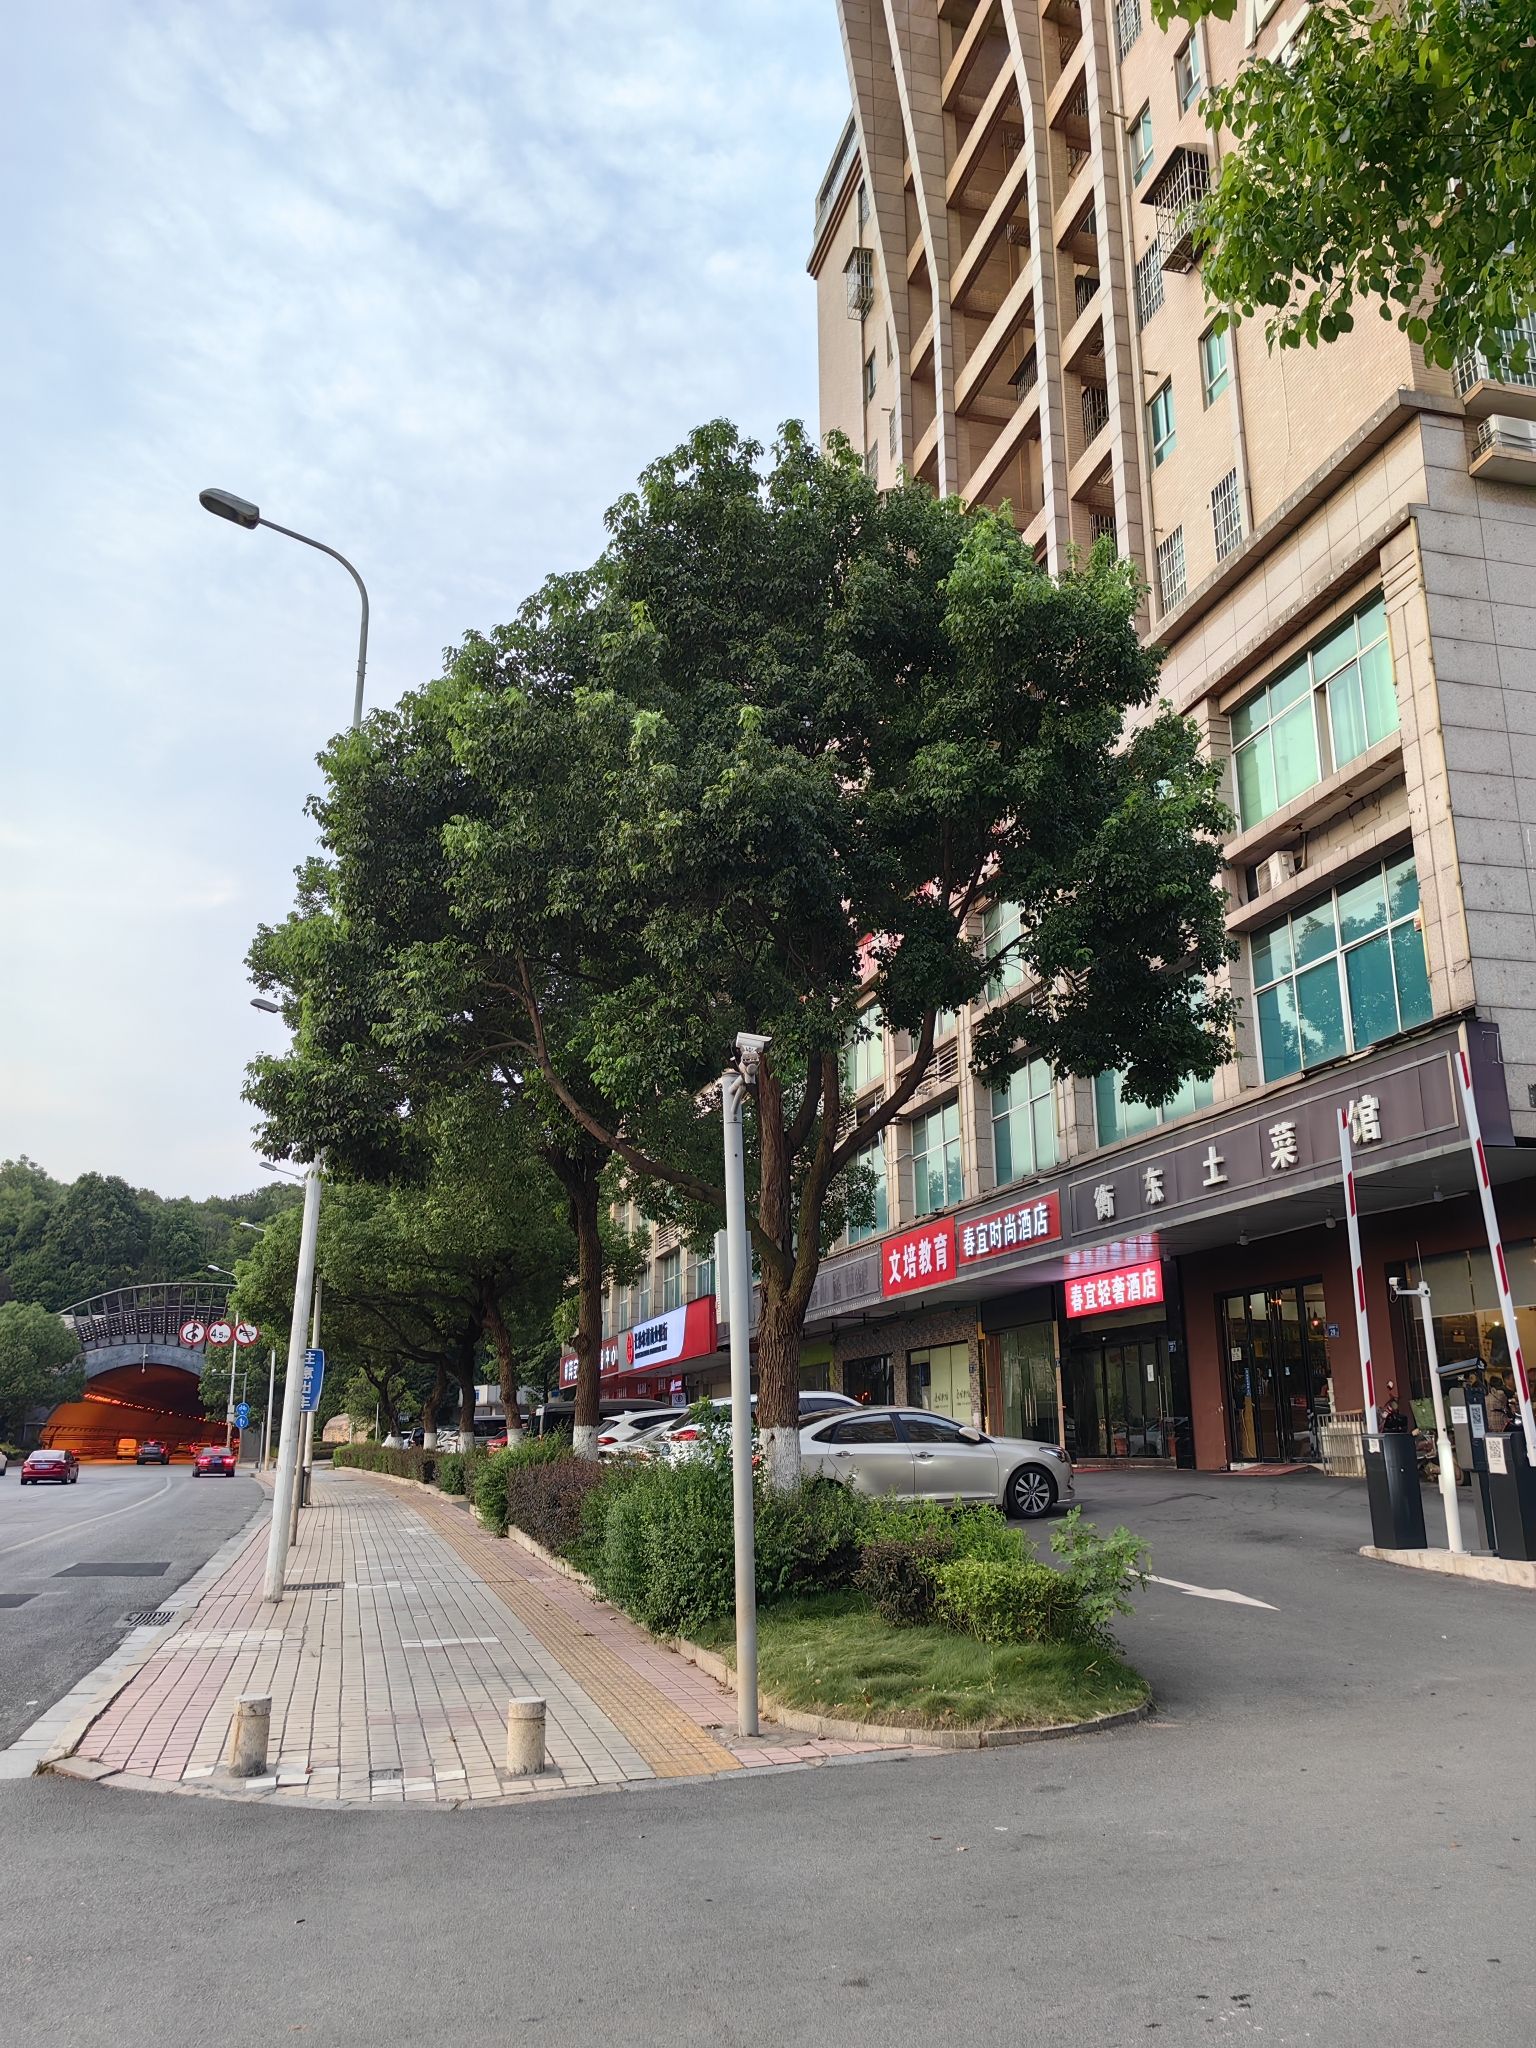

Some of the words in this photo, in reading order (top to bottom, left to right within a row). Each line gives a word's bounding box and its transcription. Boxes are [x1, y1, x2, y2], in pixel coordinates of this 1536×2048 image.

[1093, 1094, 1381, 1221] 衡东土菜馆
[963, 1202, 1048, 1257] 春宜时尚酒店
[889, 1233, 948, 1285] 文培教育
[1070, 1268, 1157, 1312] 春宜轻奢酒店
